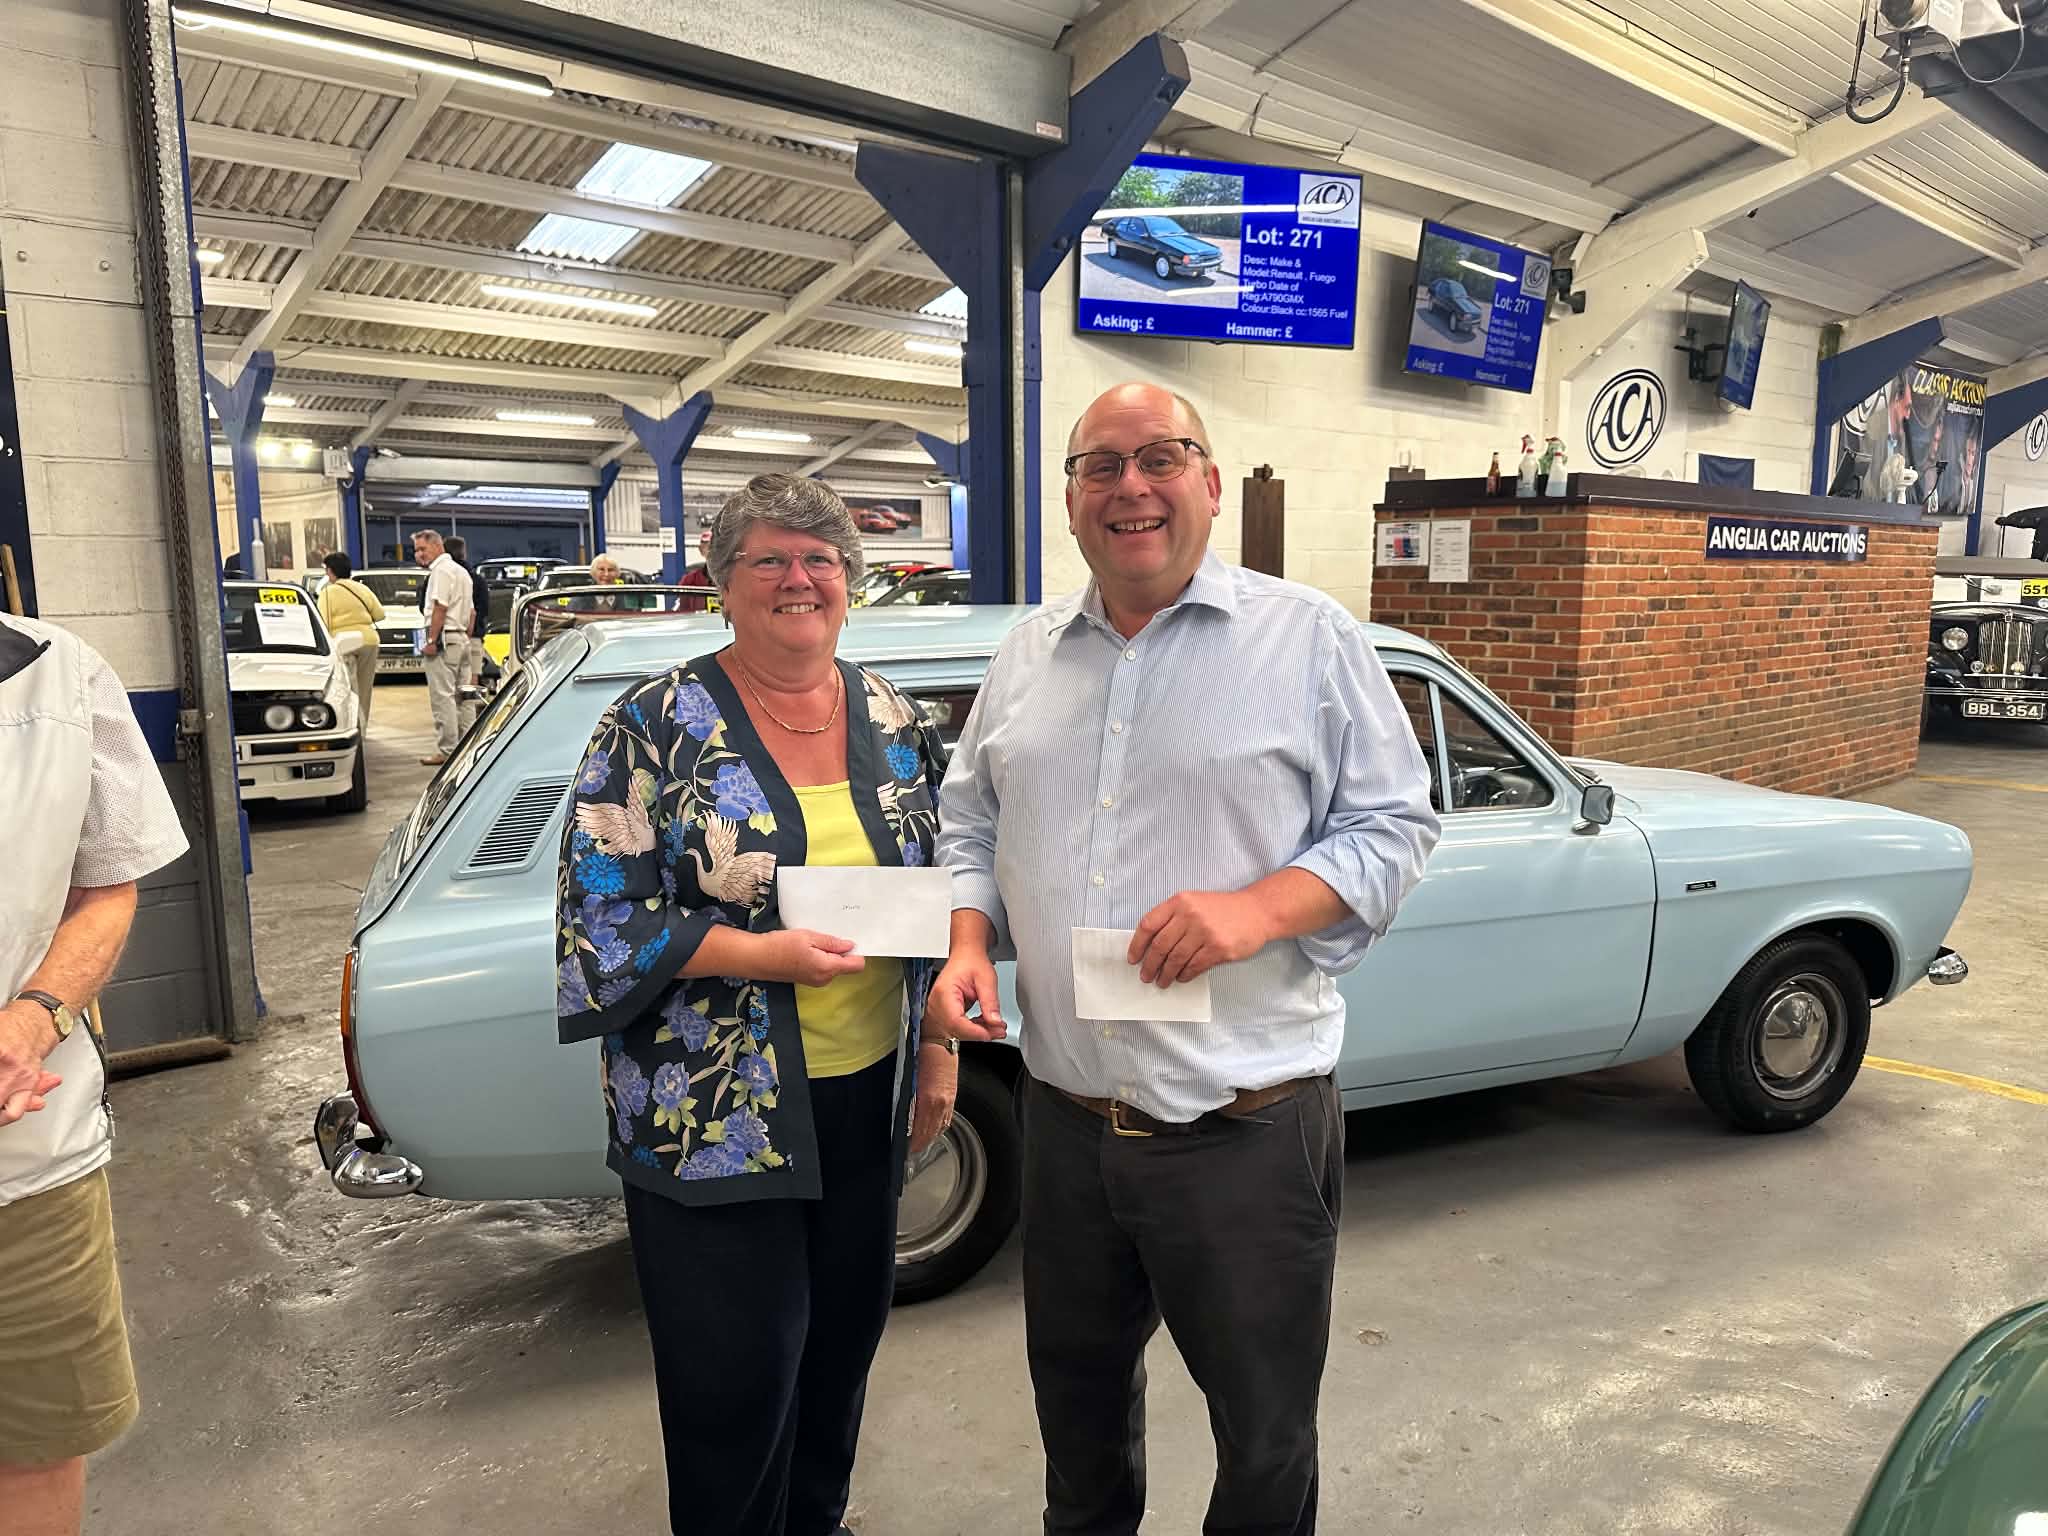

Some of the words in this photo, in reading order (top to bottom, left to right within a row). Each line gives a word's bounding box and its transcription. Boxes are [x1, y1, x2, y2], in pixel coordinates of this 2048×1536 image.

[1246, 224, 1284, 246] Lot:
[1289, 228, 1322, 249] 271
[1243, 254, 1268, 266] Desc:
[1269, 256, 1293, 268] Make
[1294, 258, 1302, 268] &
[1268, 280, 1290, 291] Date
[1290, 282, 1300, 292] of
[1309, 271, 1336, 284] Fuego
[1494, 292, 1513, 311] Lot:
[1514, 297, 1530, 315] 271
[1329, 308, 1348, 319] Fuel
[1093, 313, 1143, 332] Asking:
[1146, 317, 1155, 330] £
[1226, 322, 1282, 338] Hammer:
[1284, 326, 1293, 338] £
[1592, 382, 1656, 452] ACA
[1709, 525, 1768, 551] ANGLIA
[1770, 528, 1799, 552] CAR
[1801, 530, 1866, 554] AUCTIONS
[1967, 702, 2001, 716] BBL
[2005, 704, 2039, 717] 354
